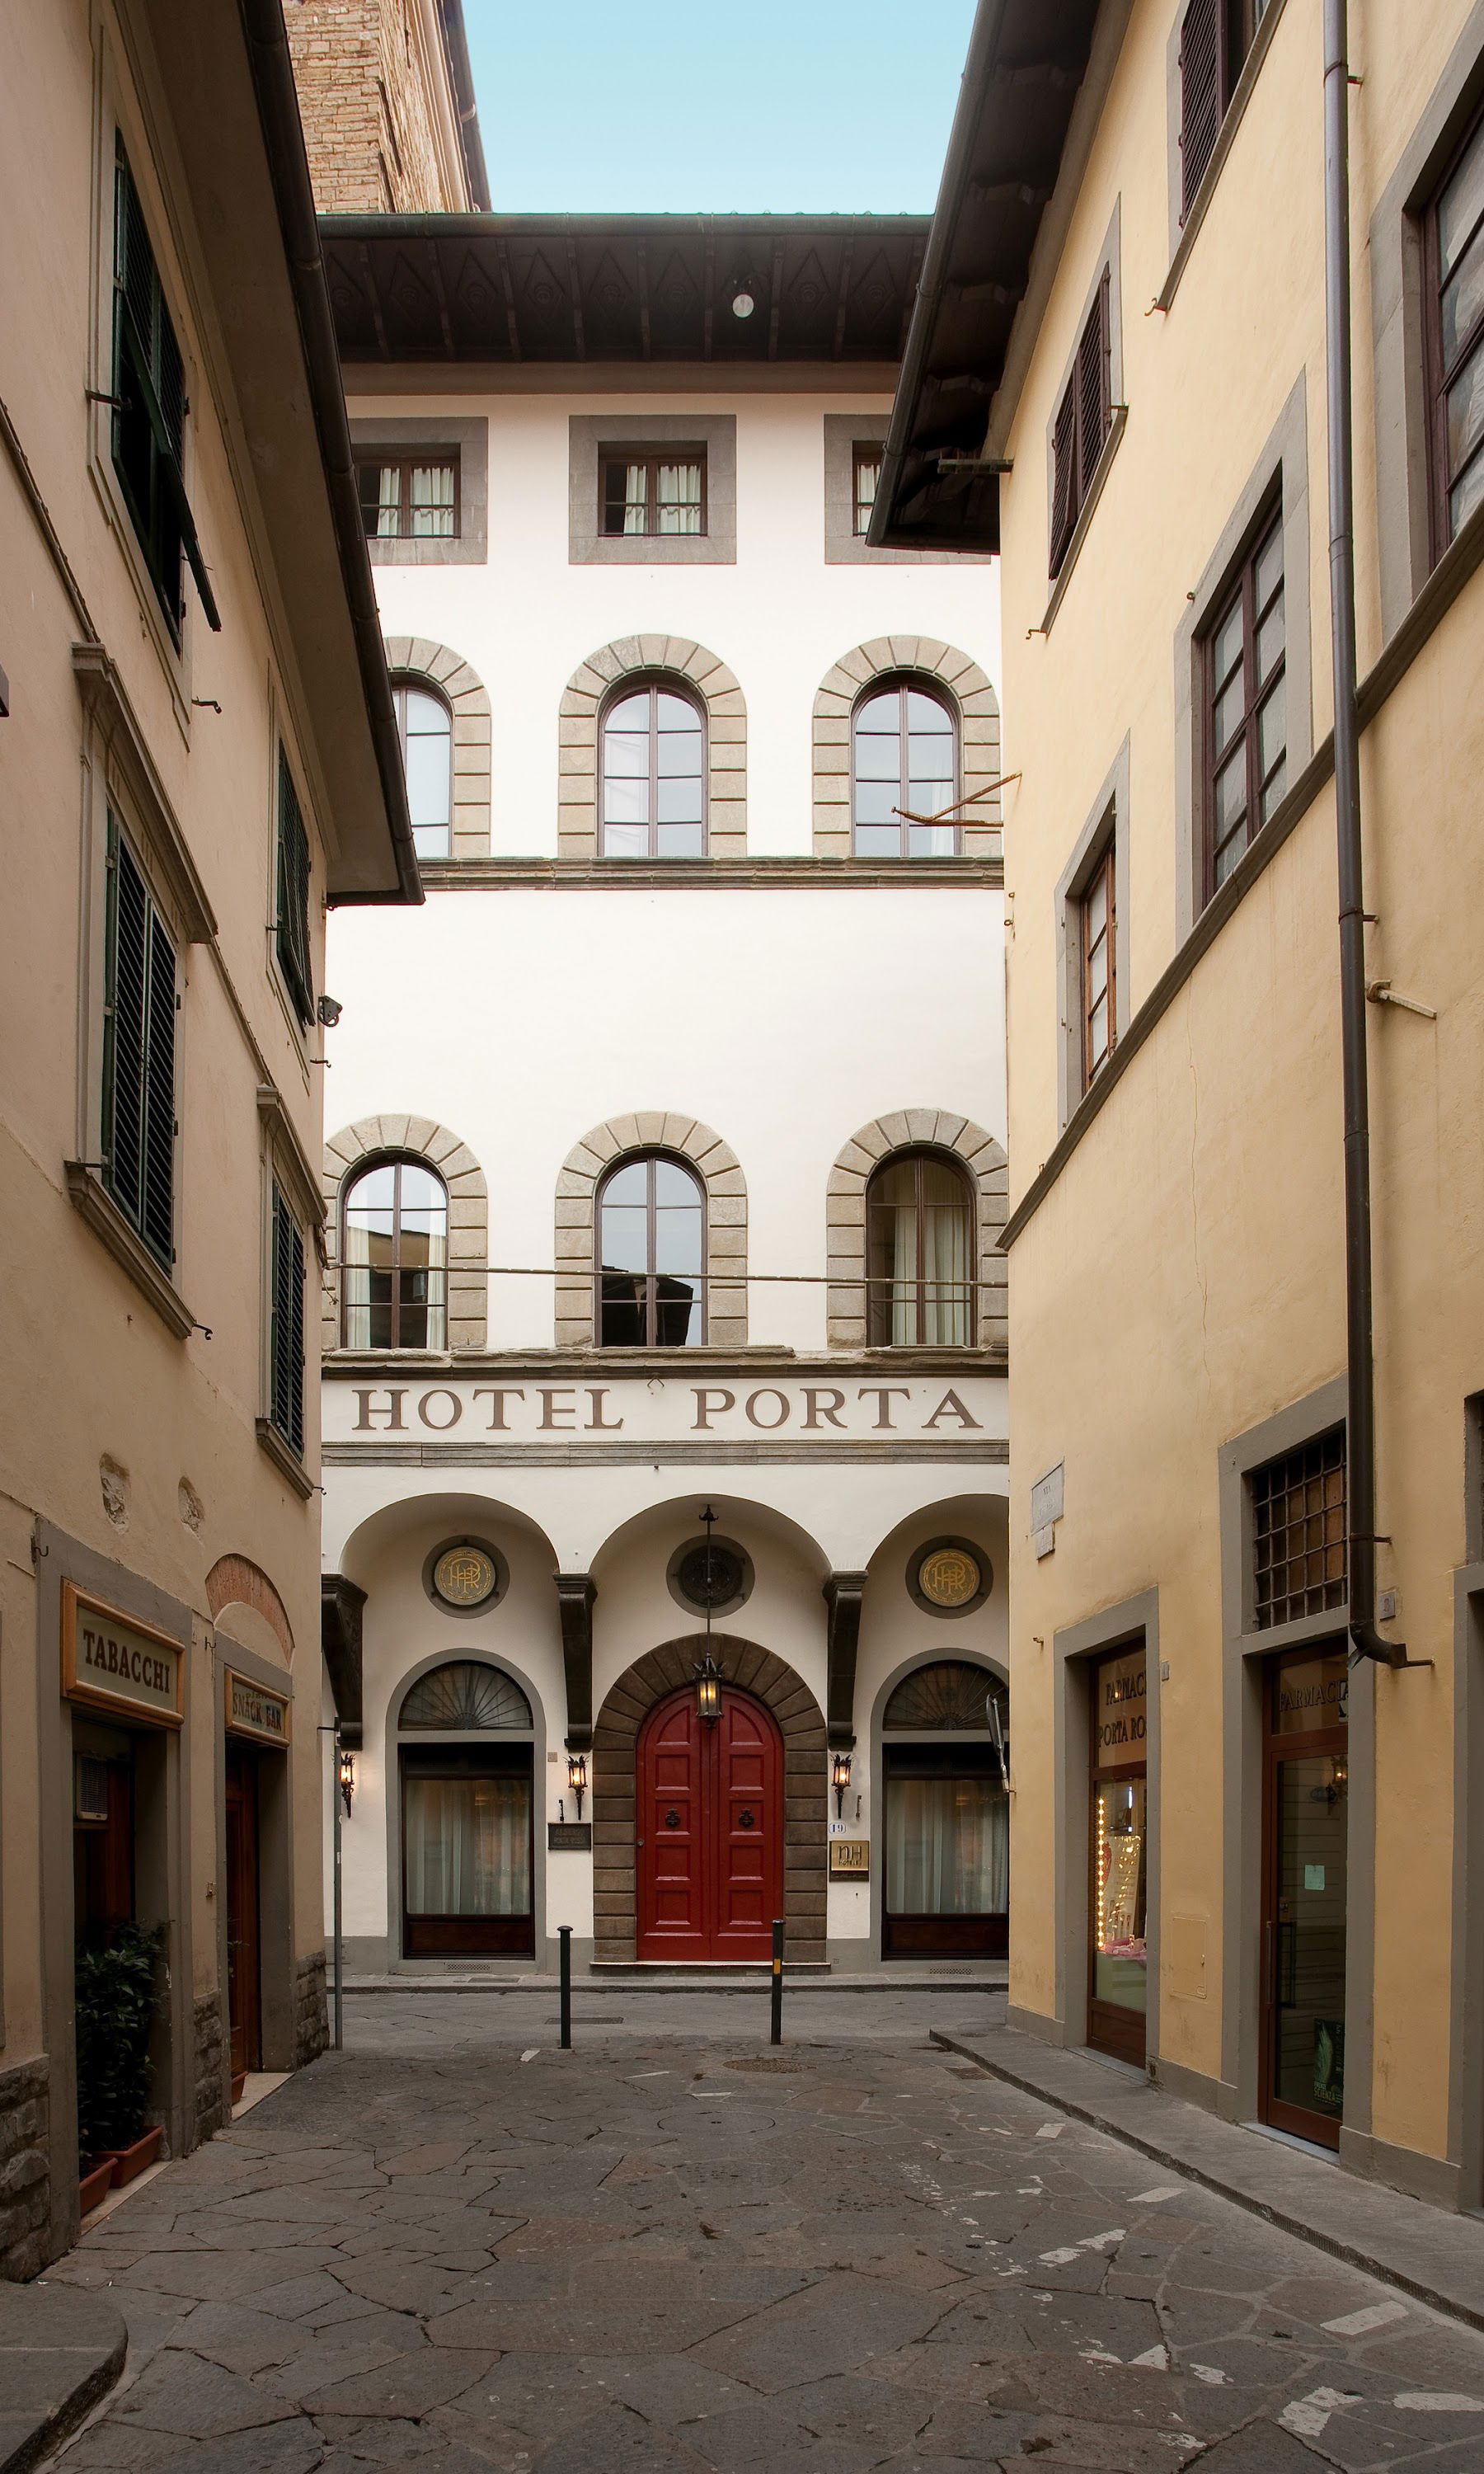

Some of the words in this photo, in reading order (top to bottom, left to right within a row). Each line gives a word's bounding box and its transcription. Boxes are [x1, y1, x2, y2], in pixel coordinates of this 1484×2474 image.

[350, 1388, 624, 1431] HOTEL
[689, 1387, 984, 1430] PORTA
[82, 1628, 170, 1694] TABACCHI
[232, 1692, 263, 1724] SNACK
[265, 1705, 282, 1731] BAR
[1097, 1718, 1129, 1748] PORTA
[831, 1823, 844, 1833] 19
